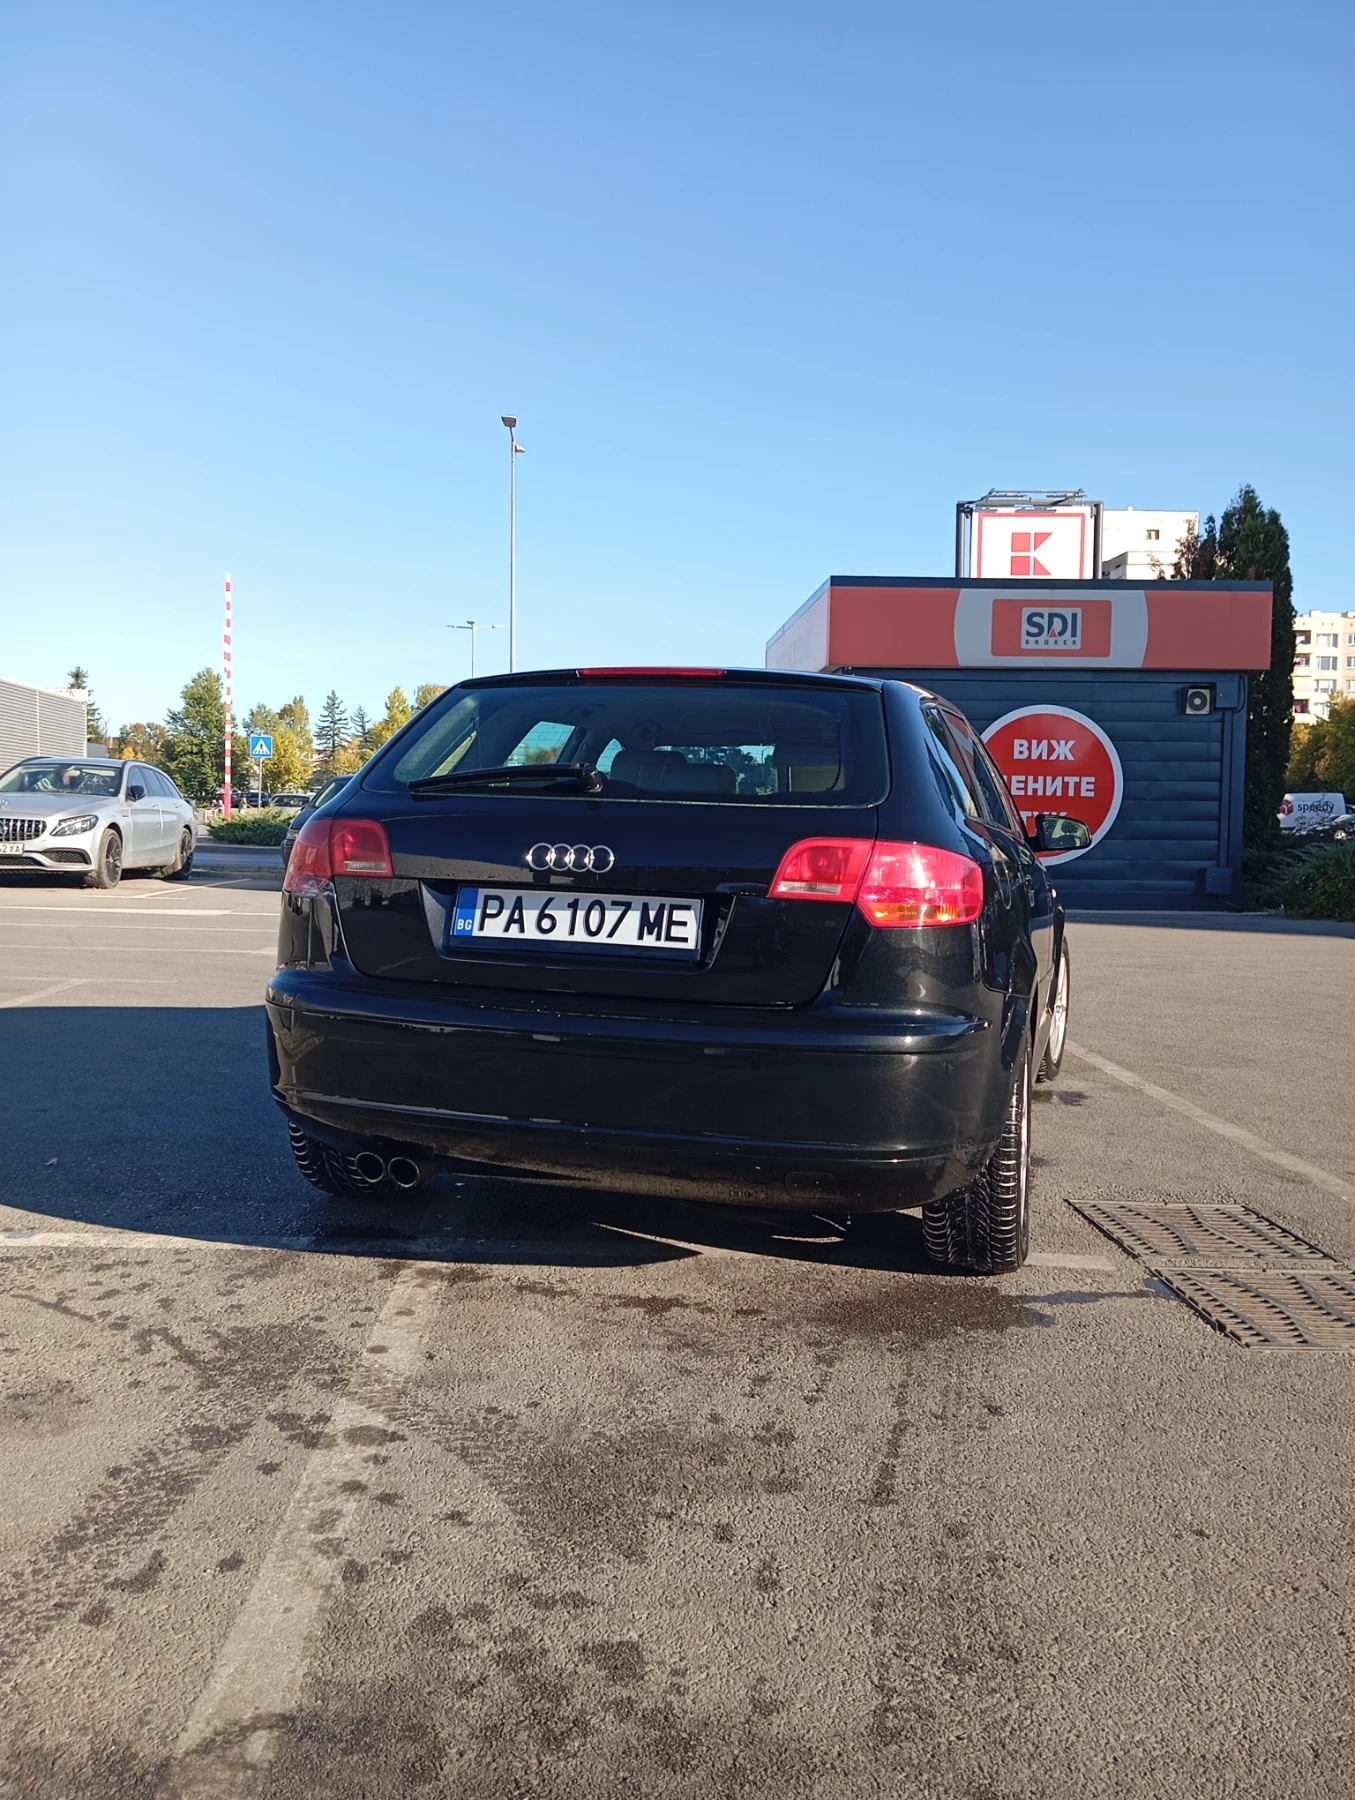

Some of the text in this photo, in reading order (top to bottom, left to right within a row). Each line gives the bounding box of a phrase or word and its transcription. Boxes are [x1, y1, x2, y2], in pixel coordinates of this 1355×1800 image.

[1010, 532, 1053, 575] K
[1025, 611, 1078, 638] SDI
[1013, 738, 1076, 761] ВИЖ
[1003, 774, 1096, 798] ЕНИТЕ
[1297, 801, 1335, 814] speedy
[456, 919, 473, 931] BG
